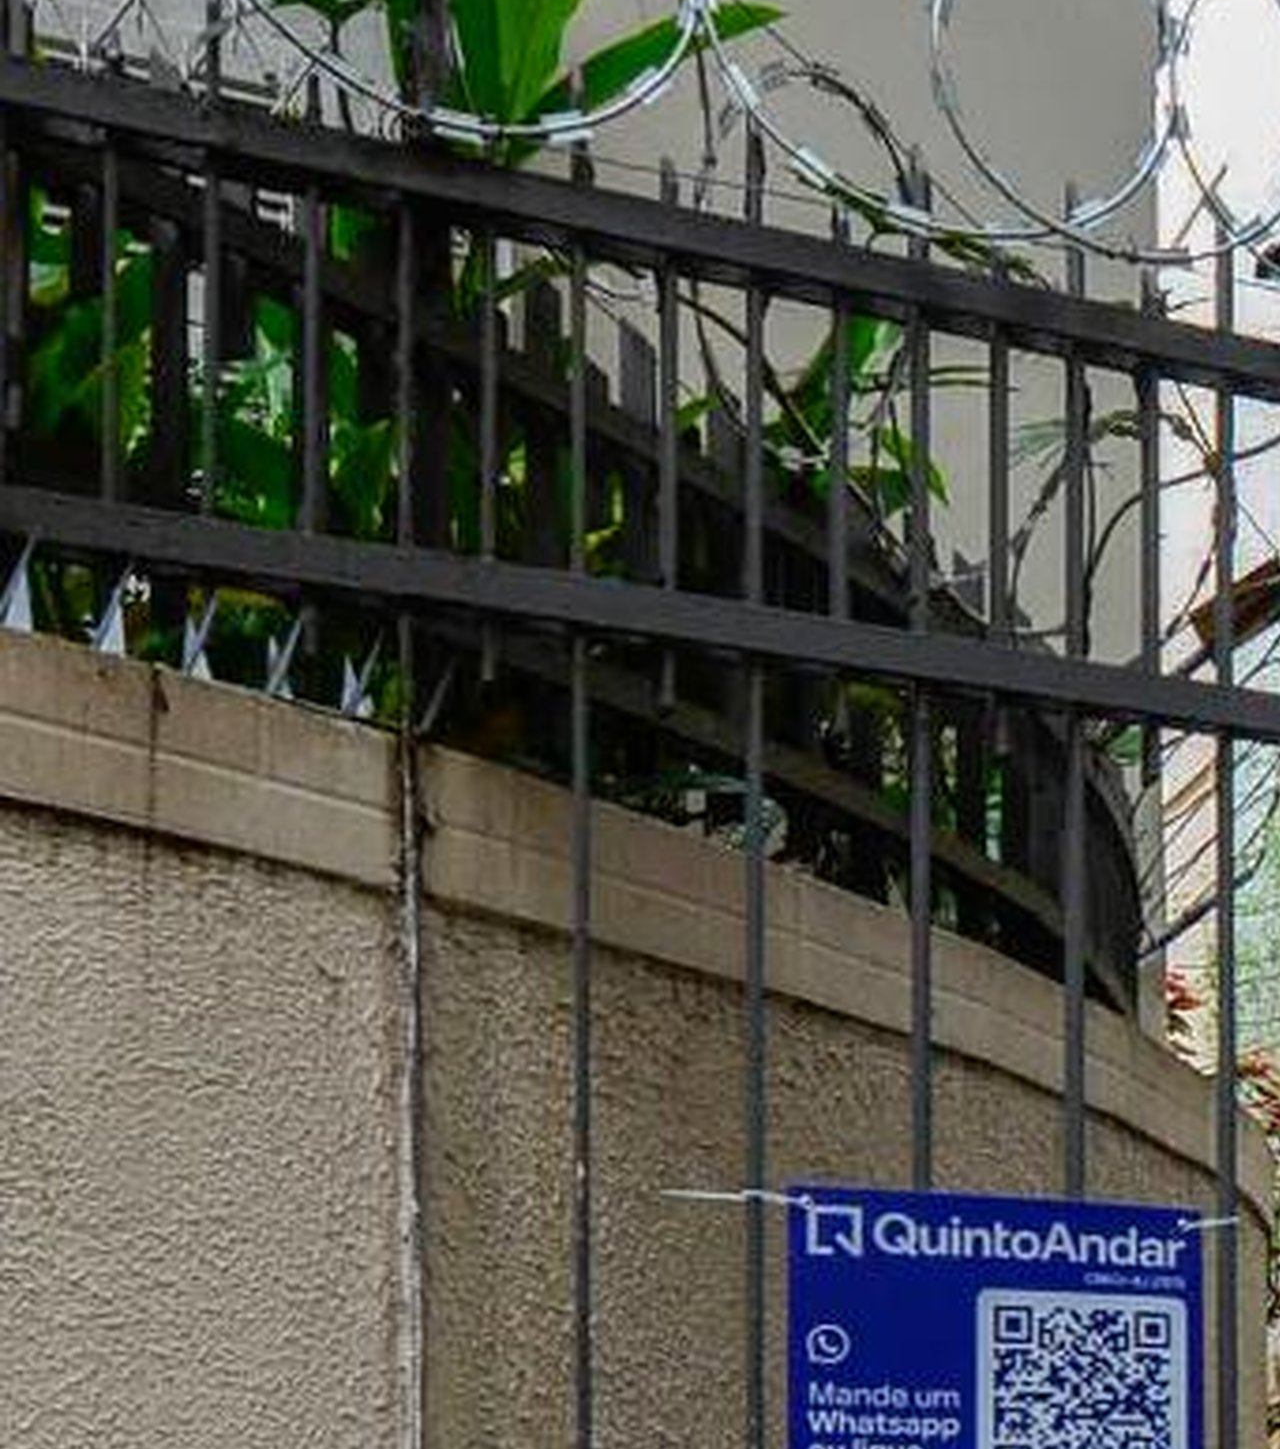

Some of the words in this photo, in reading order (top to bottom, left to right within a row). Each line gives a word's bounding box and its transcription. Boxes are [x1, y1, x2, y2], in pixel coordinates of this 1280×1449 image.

[874, 1212, 1185, 1269] QuintoAndar
[808, 1381, 908, 1408] Mande
[915, 1389, 961, 1408] um
[807, 1410, 961, 1442] Whatsapp
